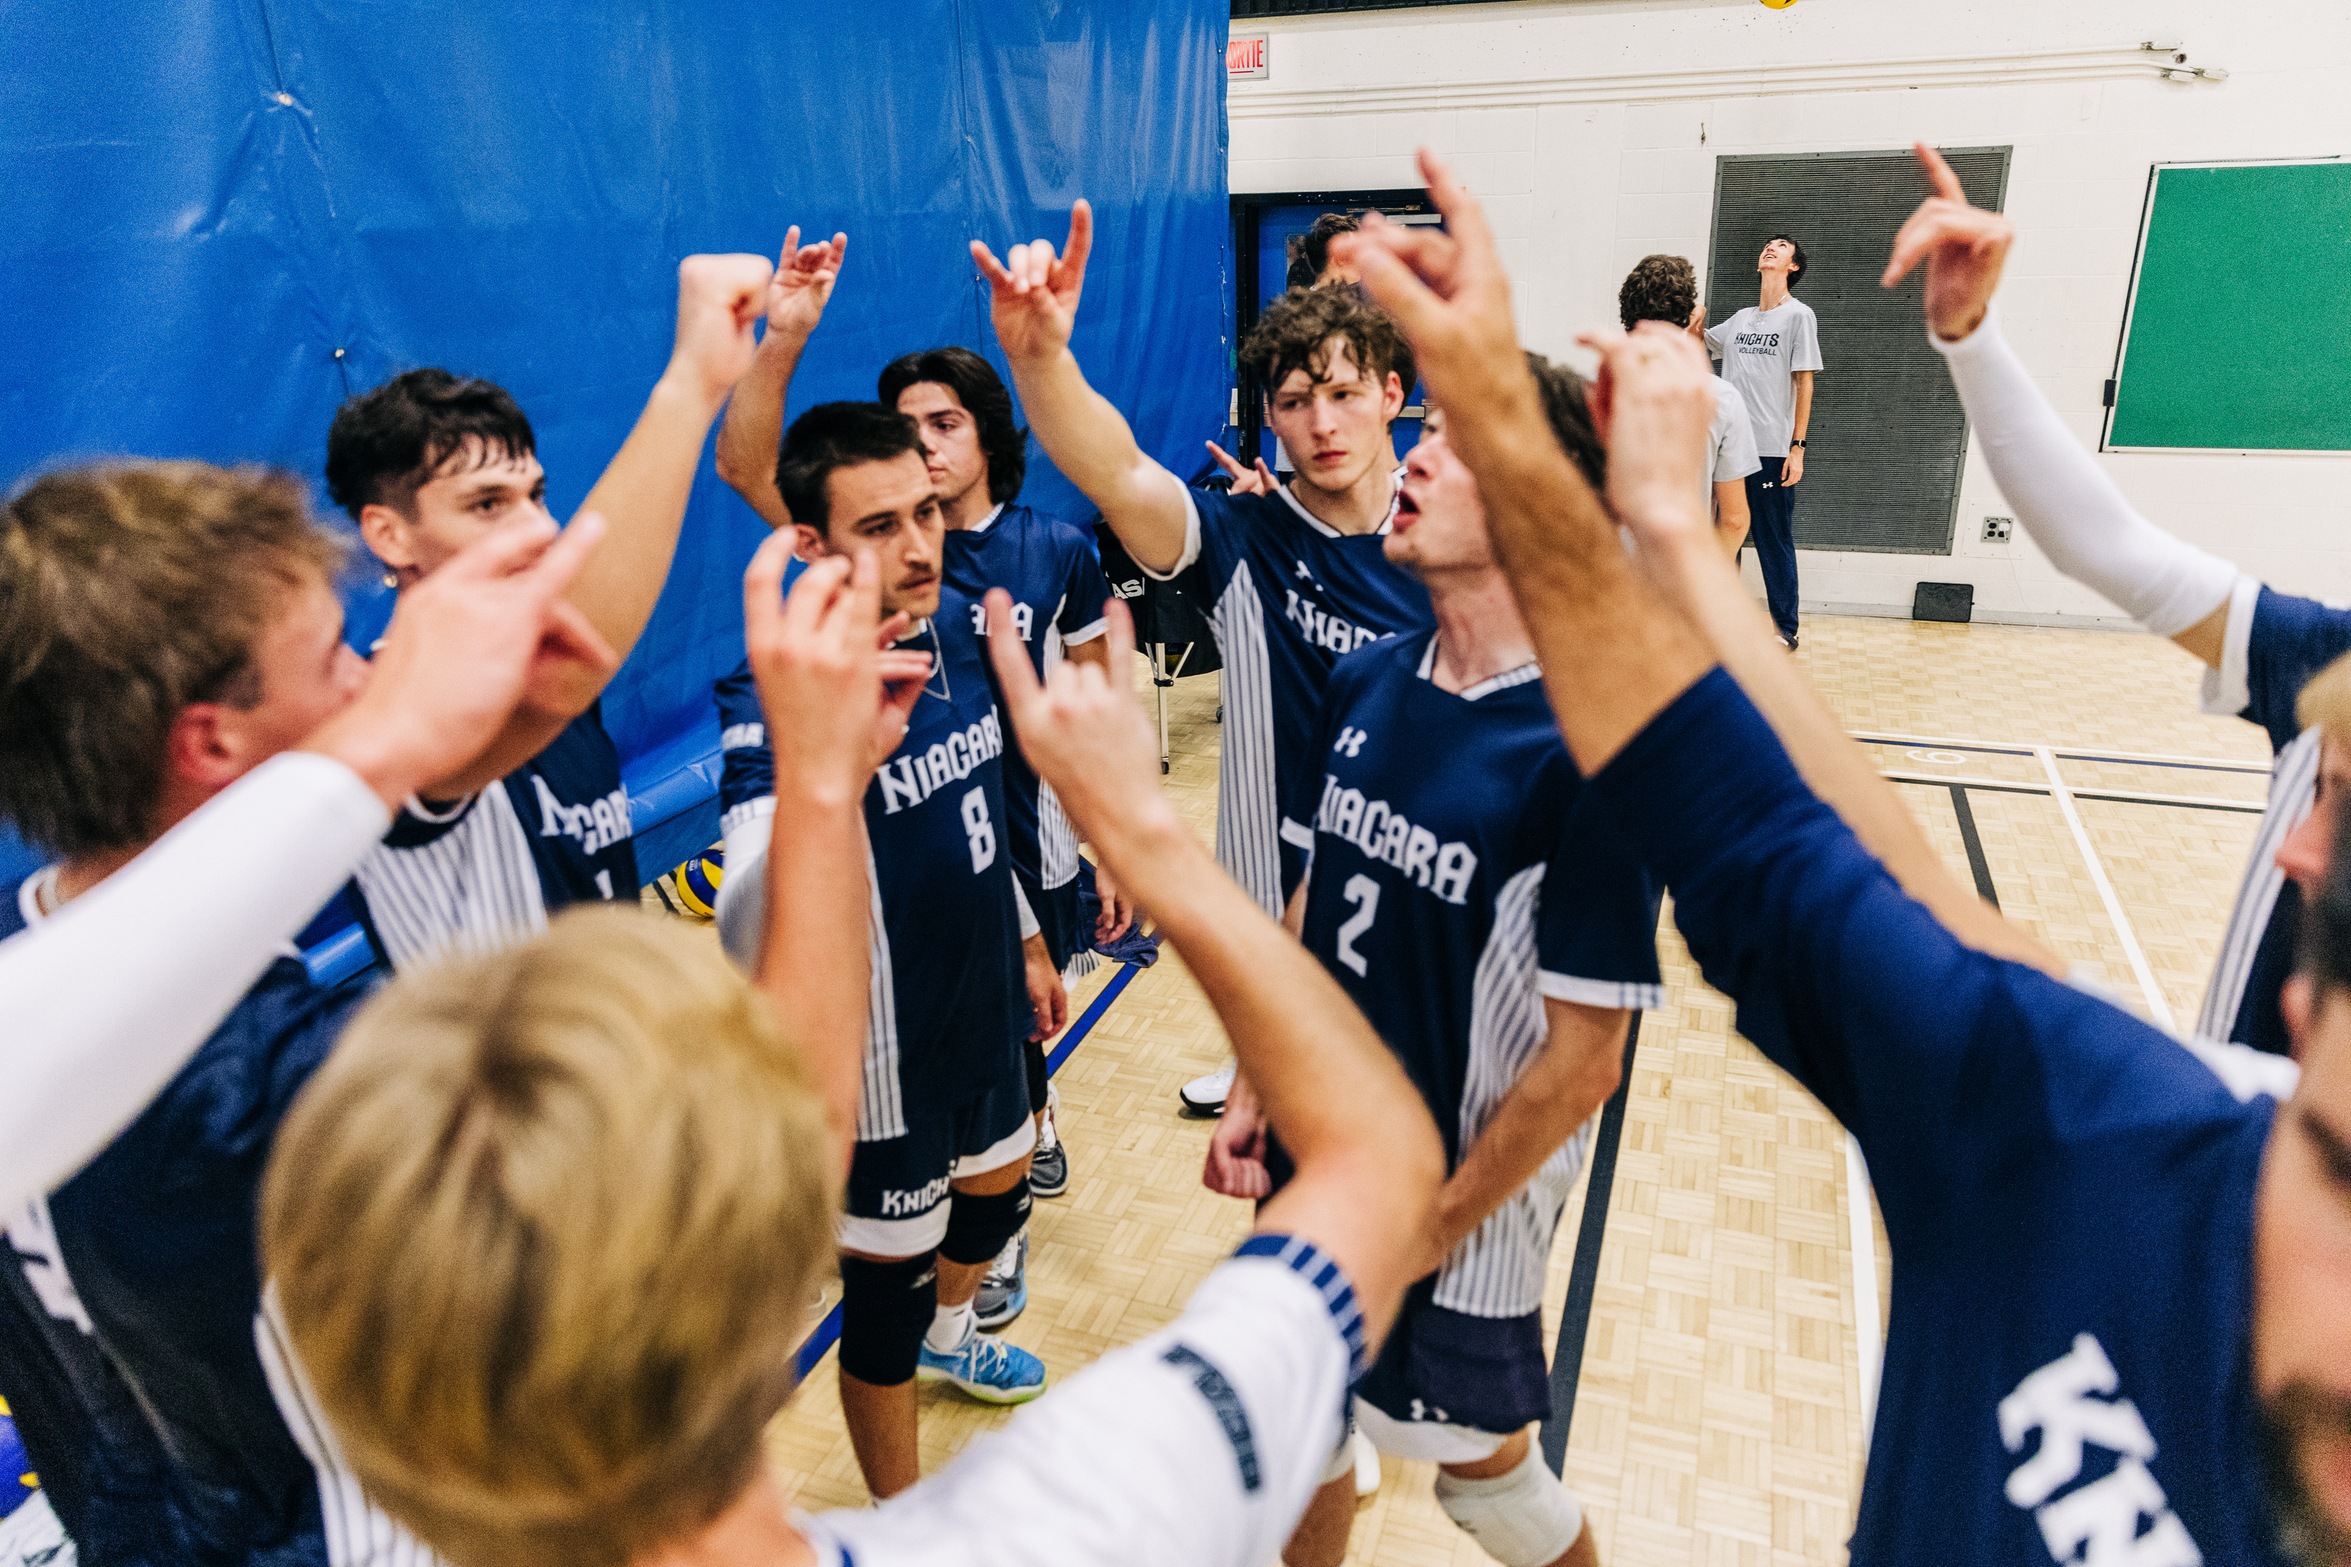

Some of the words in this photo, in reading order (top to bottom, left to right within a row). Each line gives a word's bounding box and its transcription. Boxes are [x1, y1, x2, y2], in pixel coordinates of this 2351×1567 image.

[1734, 332, 1780, 347] KNIGHTS
[1739, 347, 1777, 356] VOLLEYBALL
[960, 785, 997, 875] 8
[1337, 873, 1381, 978] 2
